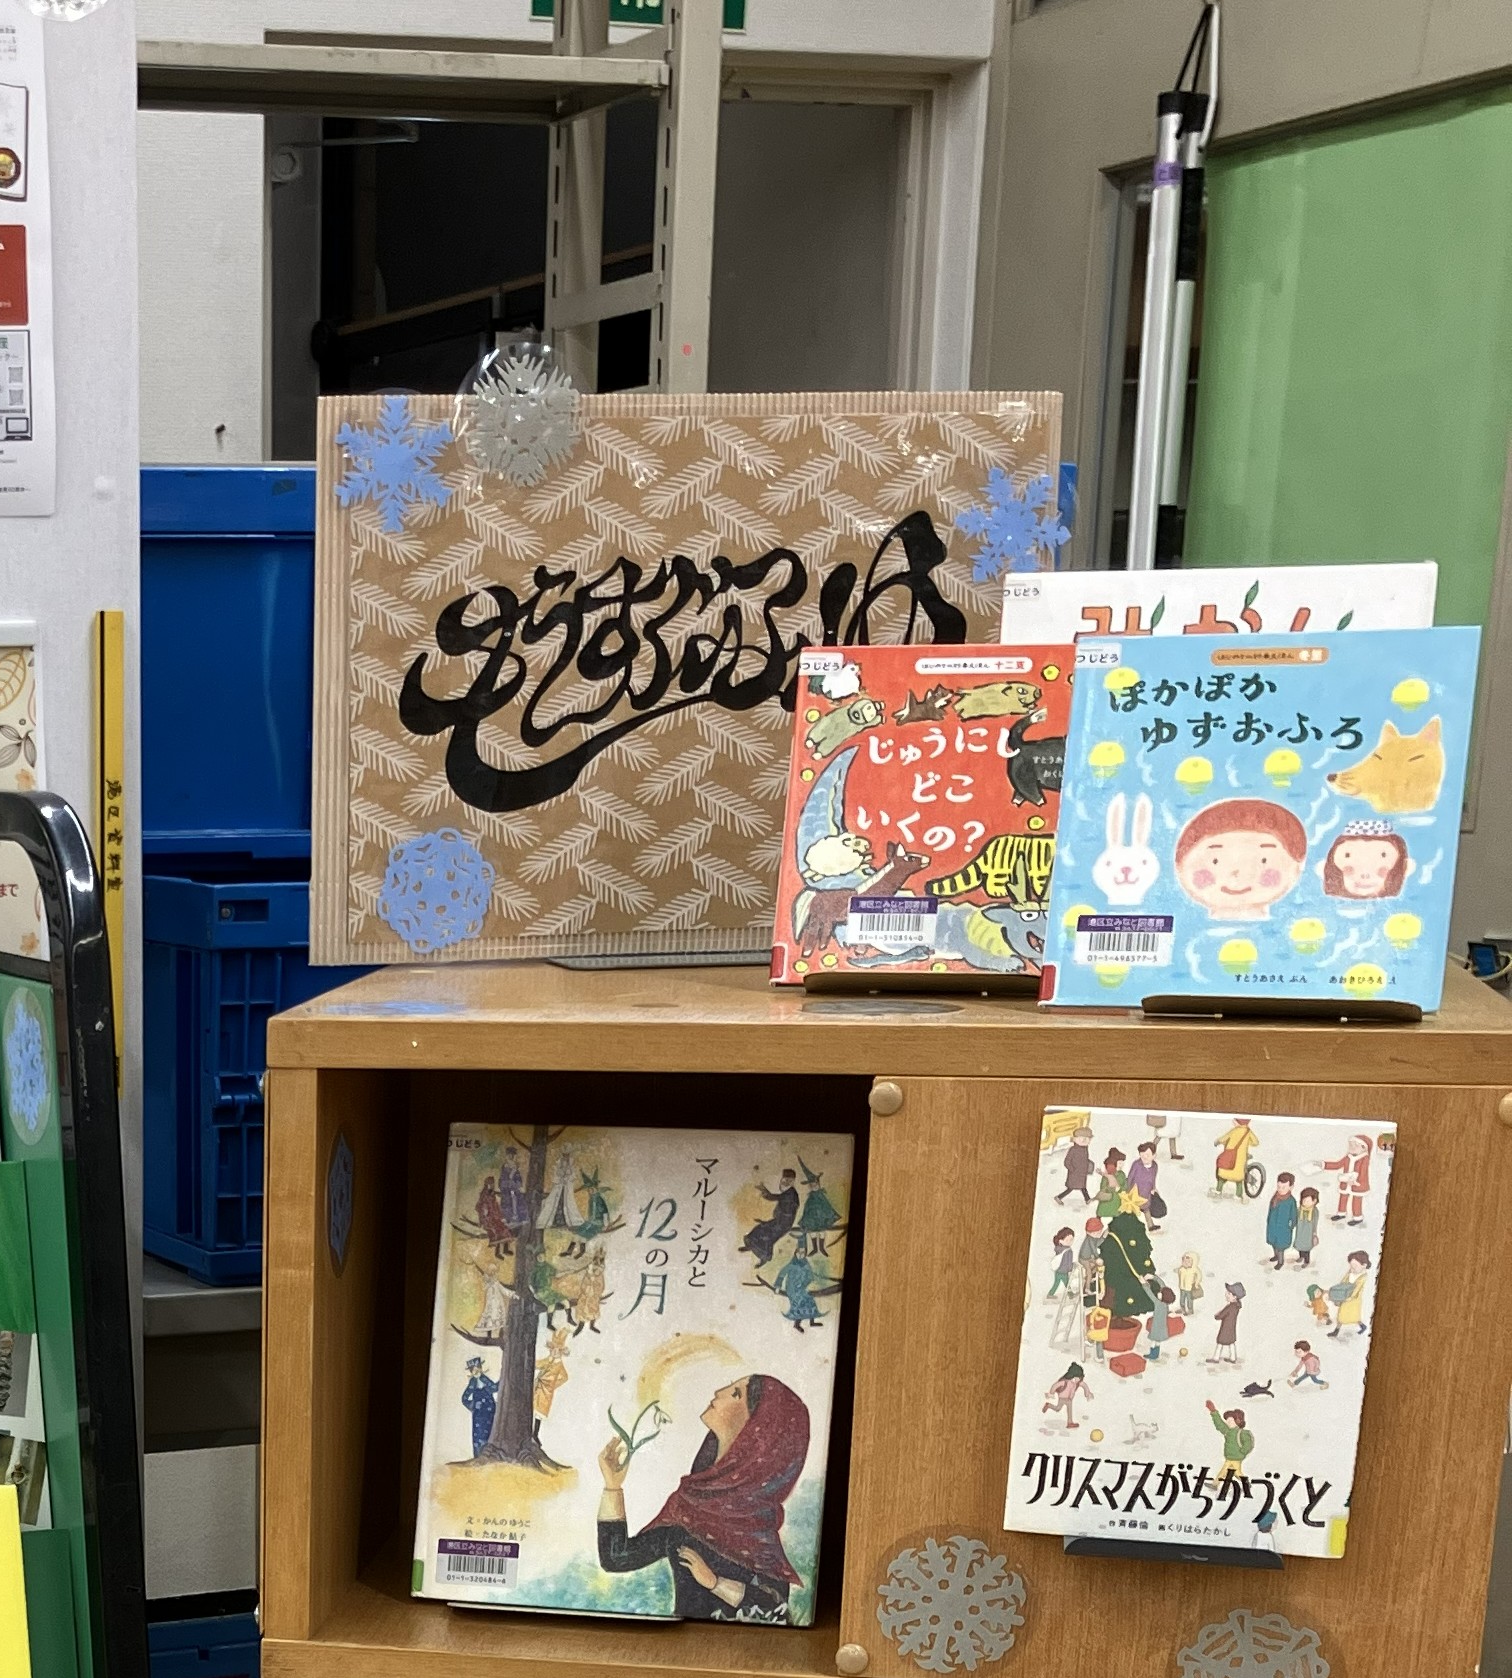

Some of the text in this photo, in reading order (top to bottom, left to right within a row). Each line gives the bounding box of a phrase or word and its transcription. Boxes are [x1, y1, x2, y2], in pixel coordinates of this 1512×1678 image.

[1108, 672, 1278, 713] ぽかぽか
[867, 726, 1021, 763] じゅうにし
[1140, 710, 1364, 753] ゆずおふろ
[911, 772, 975, 803] どこ
[855, 804, 986, 853] いくの?
[687, 1157, 720, 1289] マルーシカと
[617, 1195, 680, 1323] 12の月
[1020, 1451, 1333, 1529] クリスマスがちかづくと
